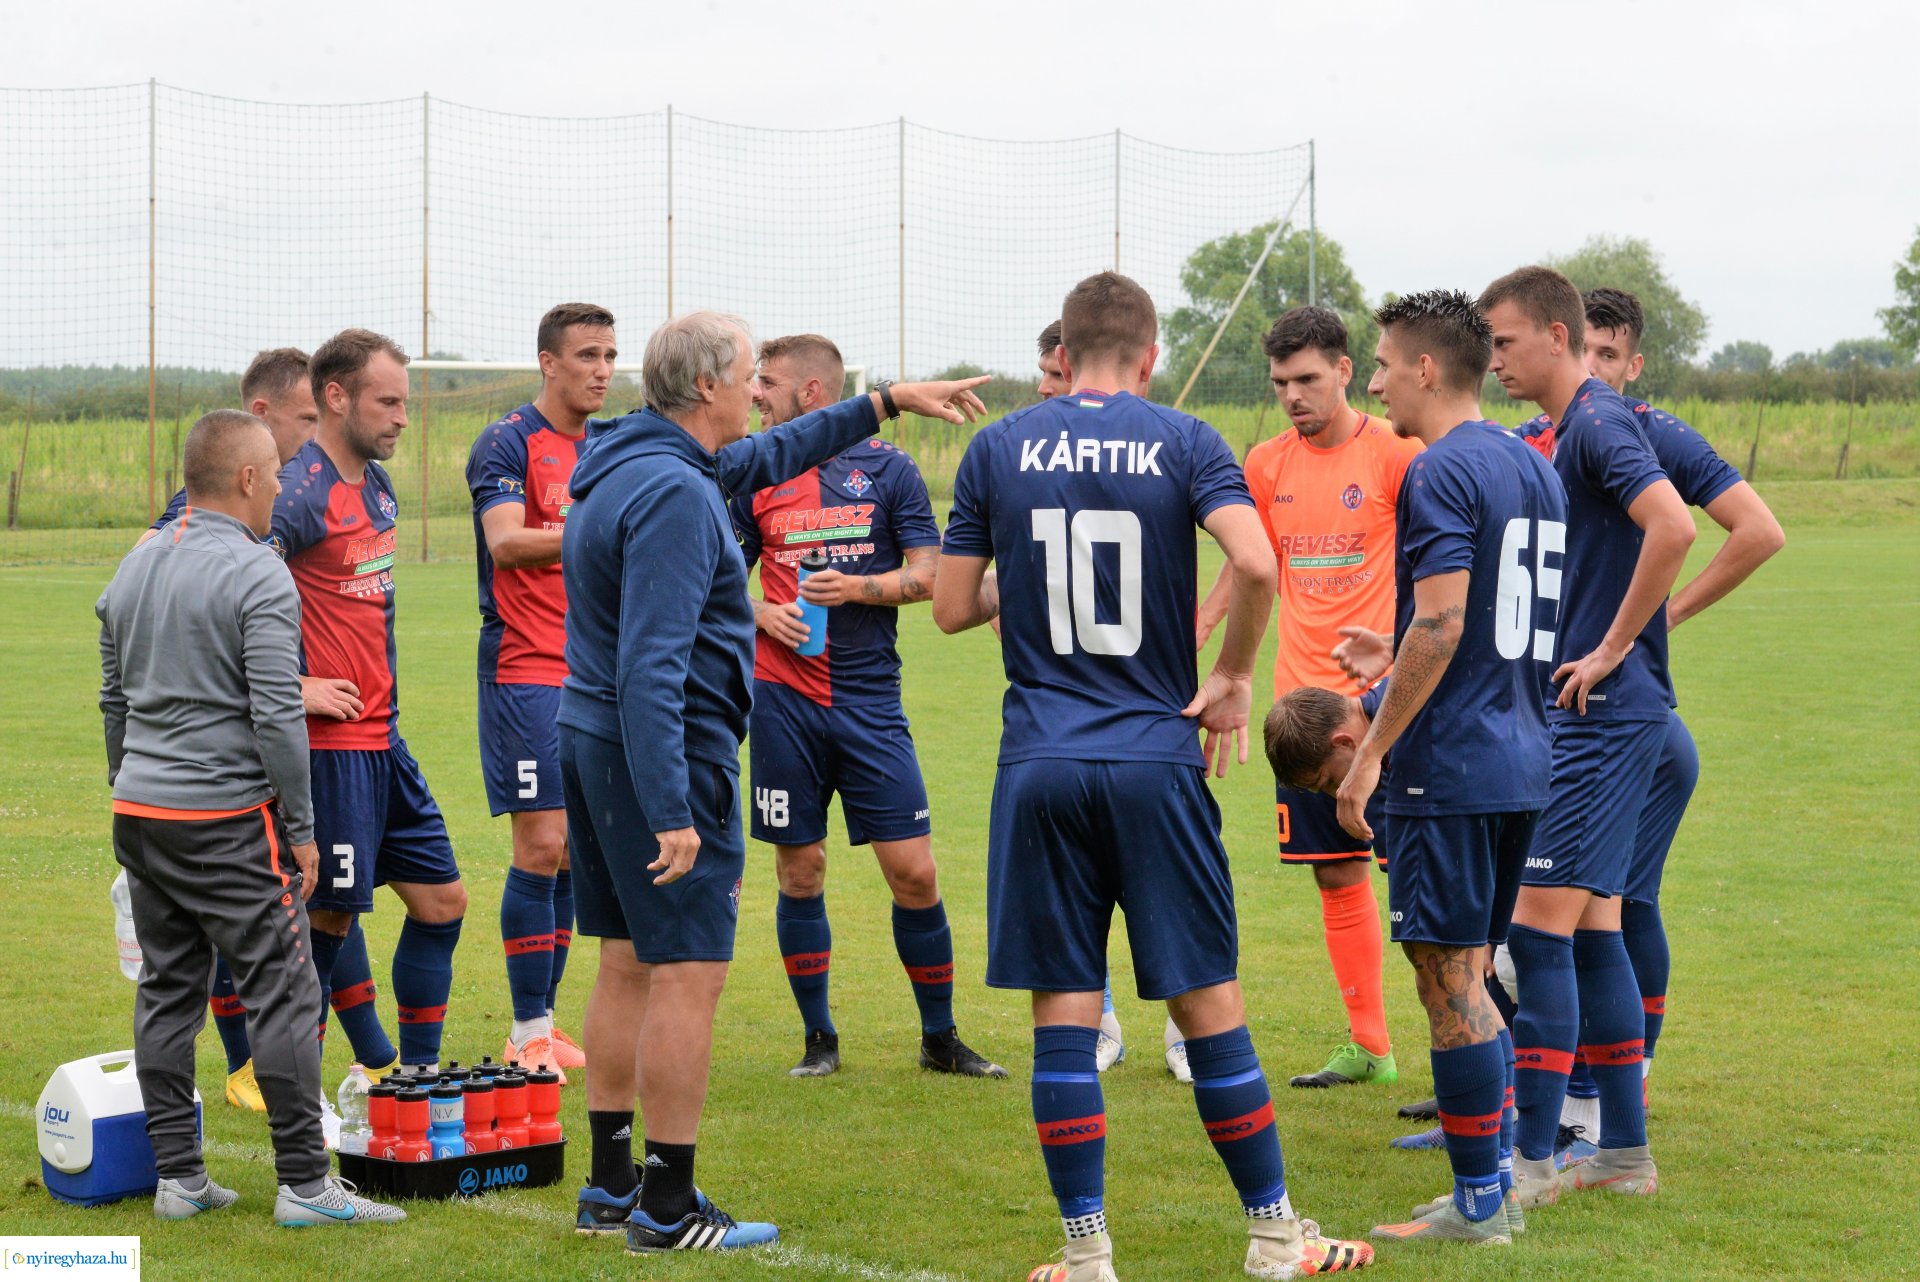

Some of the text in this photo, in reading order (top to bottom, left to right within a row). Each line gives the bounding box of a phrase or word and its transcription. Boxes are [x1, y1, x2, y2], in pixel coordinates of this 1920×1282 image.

[1020, 431, 1162, 476] KÁRTIK
[1274, 494, 1294, 503] AKO
[770, 503, 875, 535] REVESZ
[787, 534, 811, 542] ALWAYS
[822, 529, 833, 537] THE
[833, 529, 853, 537] RIGHT
[1280, 532, 1367, 556] REVESZ
[829, 543, 875, 557] TRANS
[1031, 508, 1142, 657] 10
[1325, 571, 1373, 587] TRANS
[1495, 517, 1567, 662] 65
[517, 760, 538, 799] 5
[756, 786, 790, 828] 48
[914, 808, 930, 821] JAK
[332, 844, 355, 888] 3
[1525, 857, 1553, 869] JAKO
[43, 1101, 70, 1123] jou
[1047, 1122, 1100, 1138] JAKO
[483, 1163, 528, 1188] JAKO
